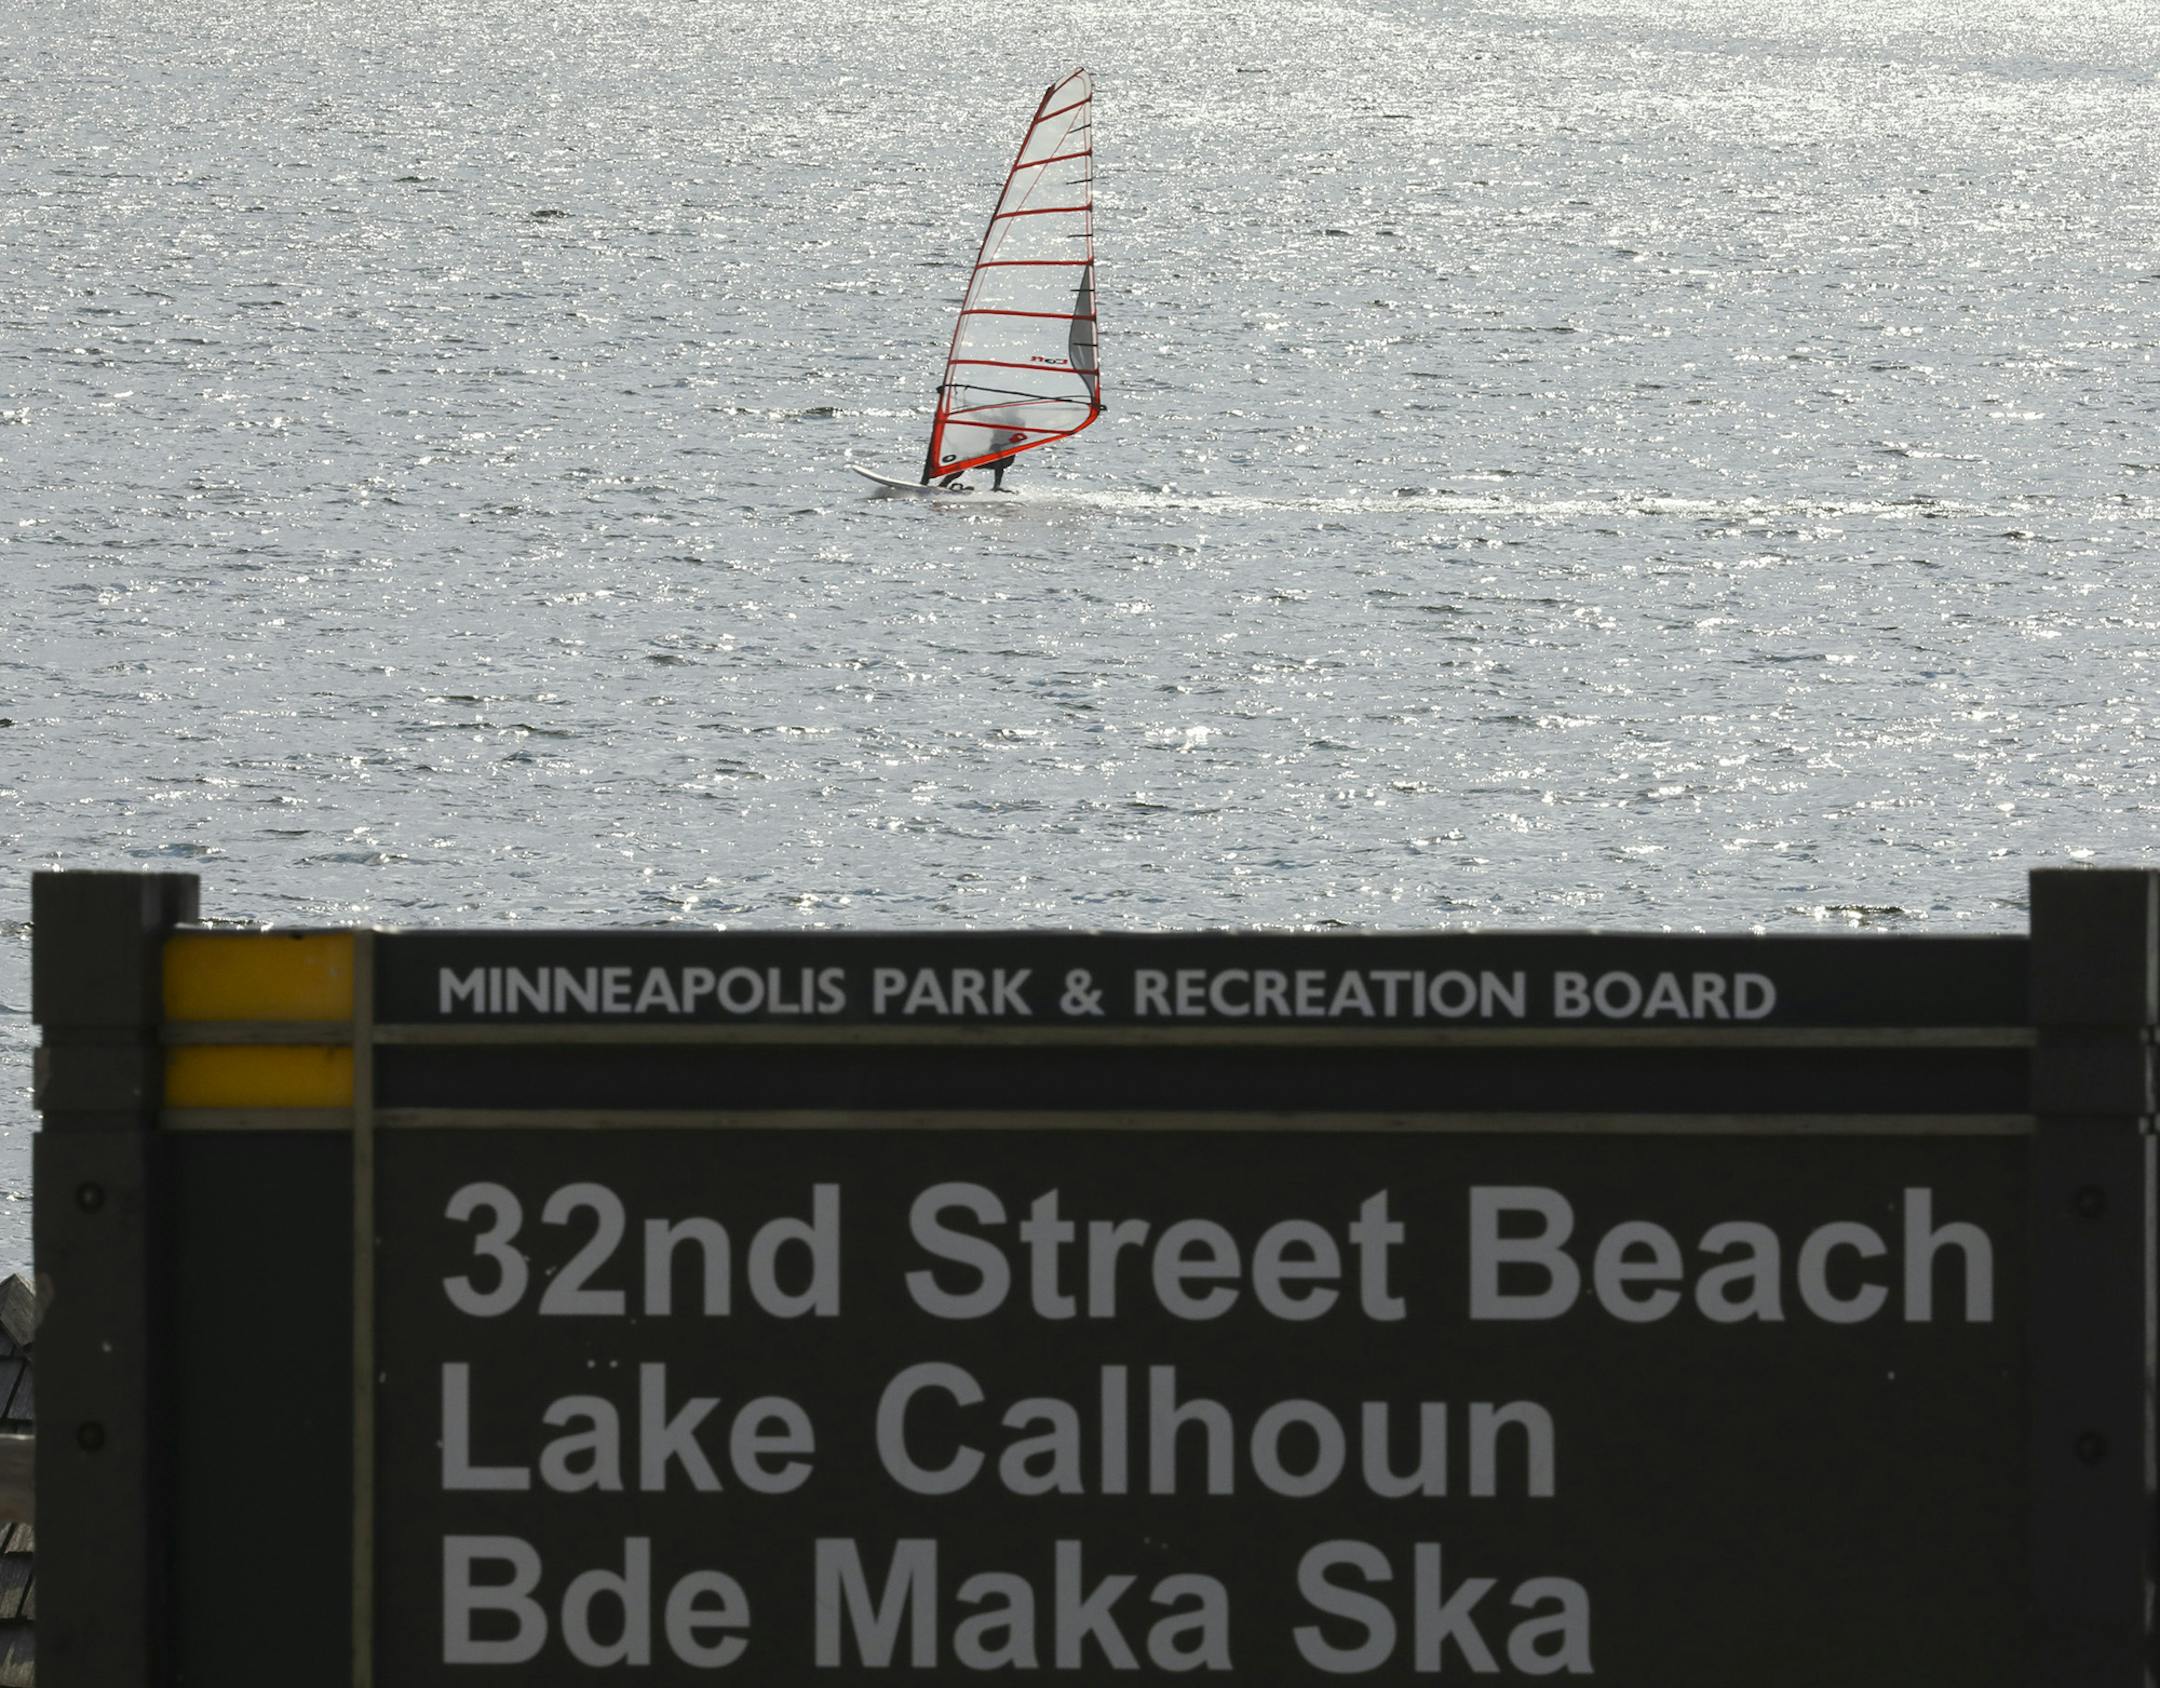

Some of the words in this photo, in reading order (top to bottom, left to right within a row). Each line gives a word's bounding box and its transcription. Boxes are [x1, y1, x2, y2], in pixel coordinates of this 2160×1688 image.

[439, 967, 845, 1013] MINNEAPOLIS
[874, 968, 1031, 1015] PARK
[1061, 970, 1104, 1015] &
[1135, 969, 1526, 1017] RECREATION
[1554, 971, 1776, 1019] BOARD
[443, 1182, 840, 1318] 32nd
[906, 1182, 1406, 1321] Street
[1470, 1186, 1994, 1323] Beach
[441, 1363, 815, 1493] Lake
[876, 1362, 1556, 1497] Calhoun
[443, 1535, 750, 1668] Bde
[816, 1538, 1232, 1671] Maka
[1294, 1540, 1593, 1675] Ska
